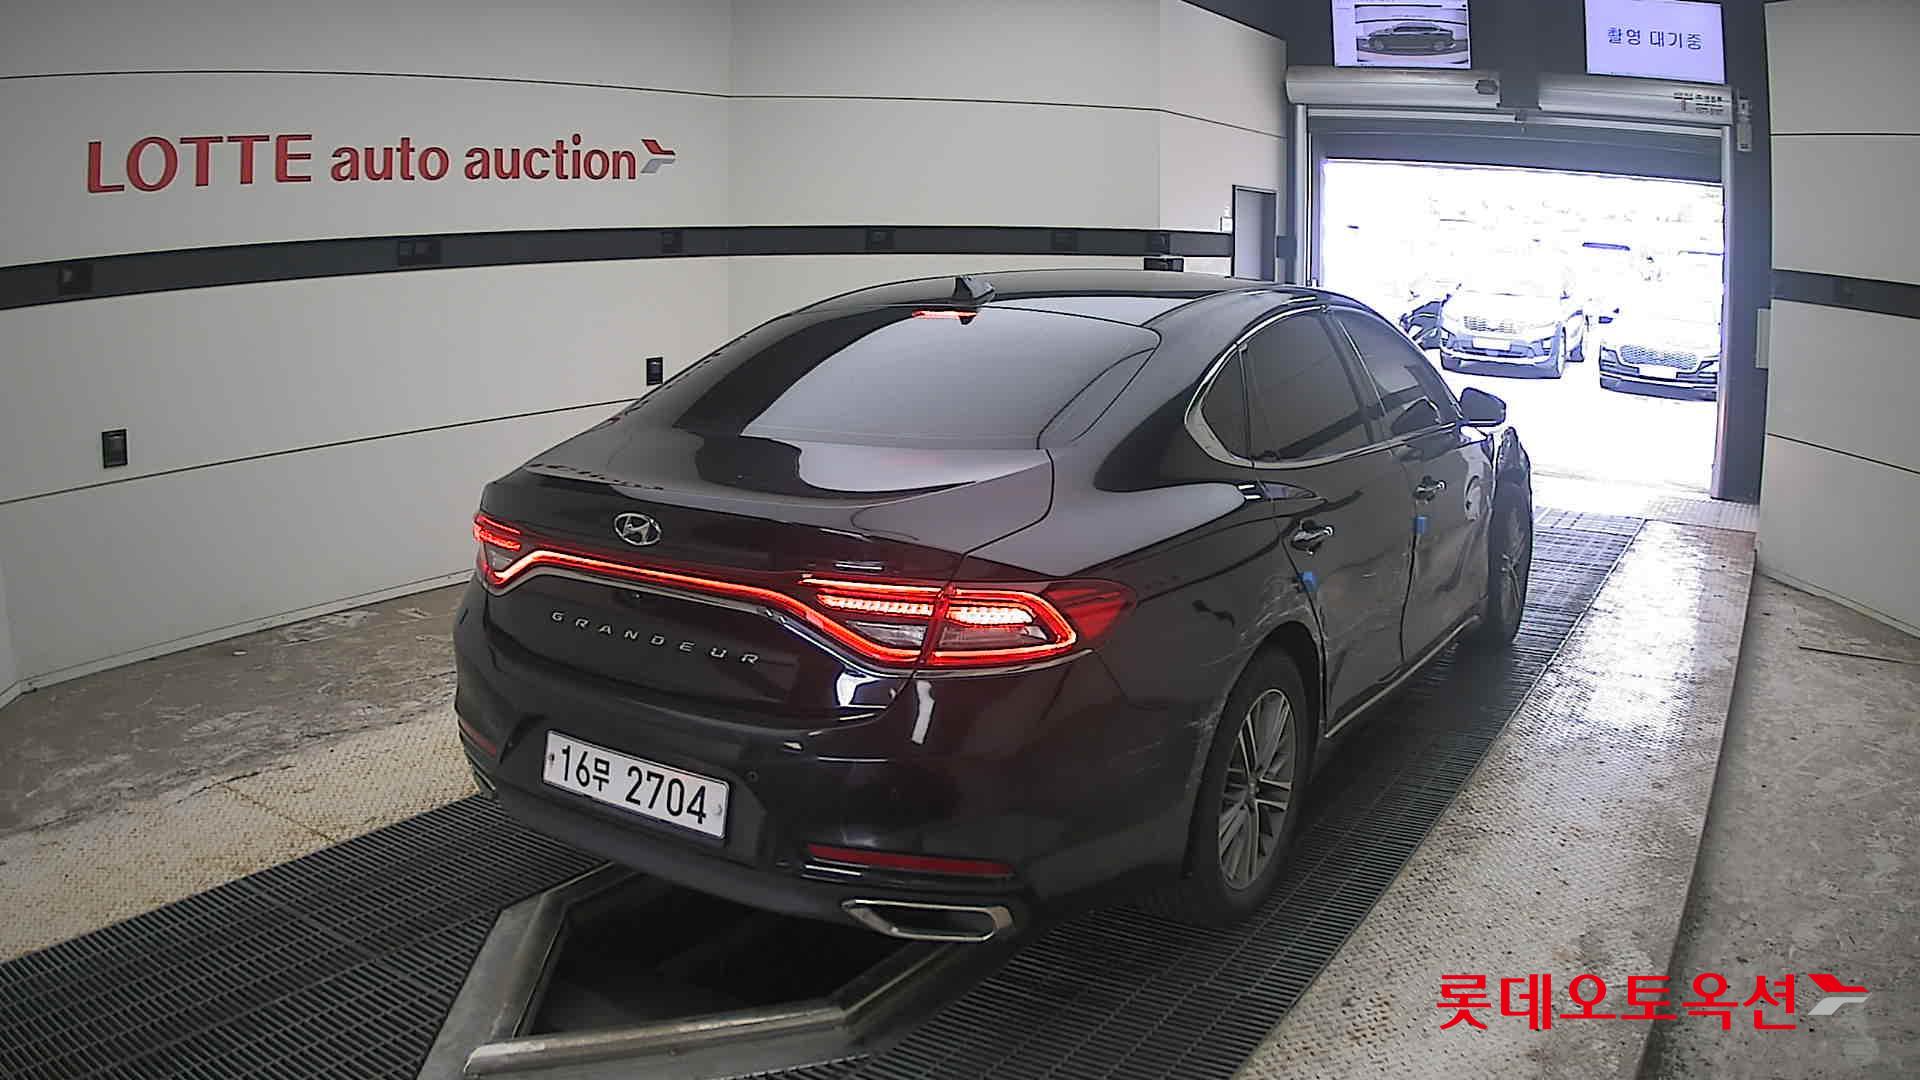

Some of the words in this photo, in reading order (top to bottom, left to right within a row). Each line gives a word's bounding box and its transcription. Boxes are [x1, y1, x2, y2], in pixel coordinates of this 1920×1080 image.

[1649, 30, 1702, 50] 대기중
[87, 134, 312, 193] LOTTE
[330, 137, 450, 182] auto
[464, 133, 637, 180] auction
[551, 611, 759, 664] GRANDEUR
[561, 745, 610, 792] 16무
[625, 766, 706, 824] 2704
